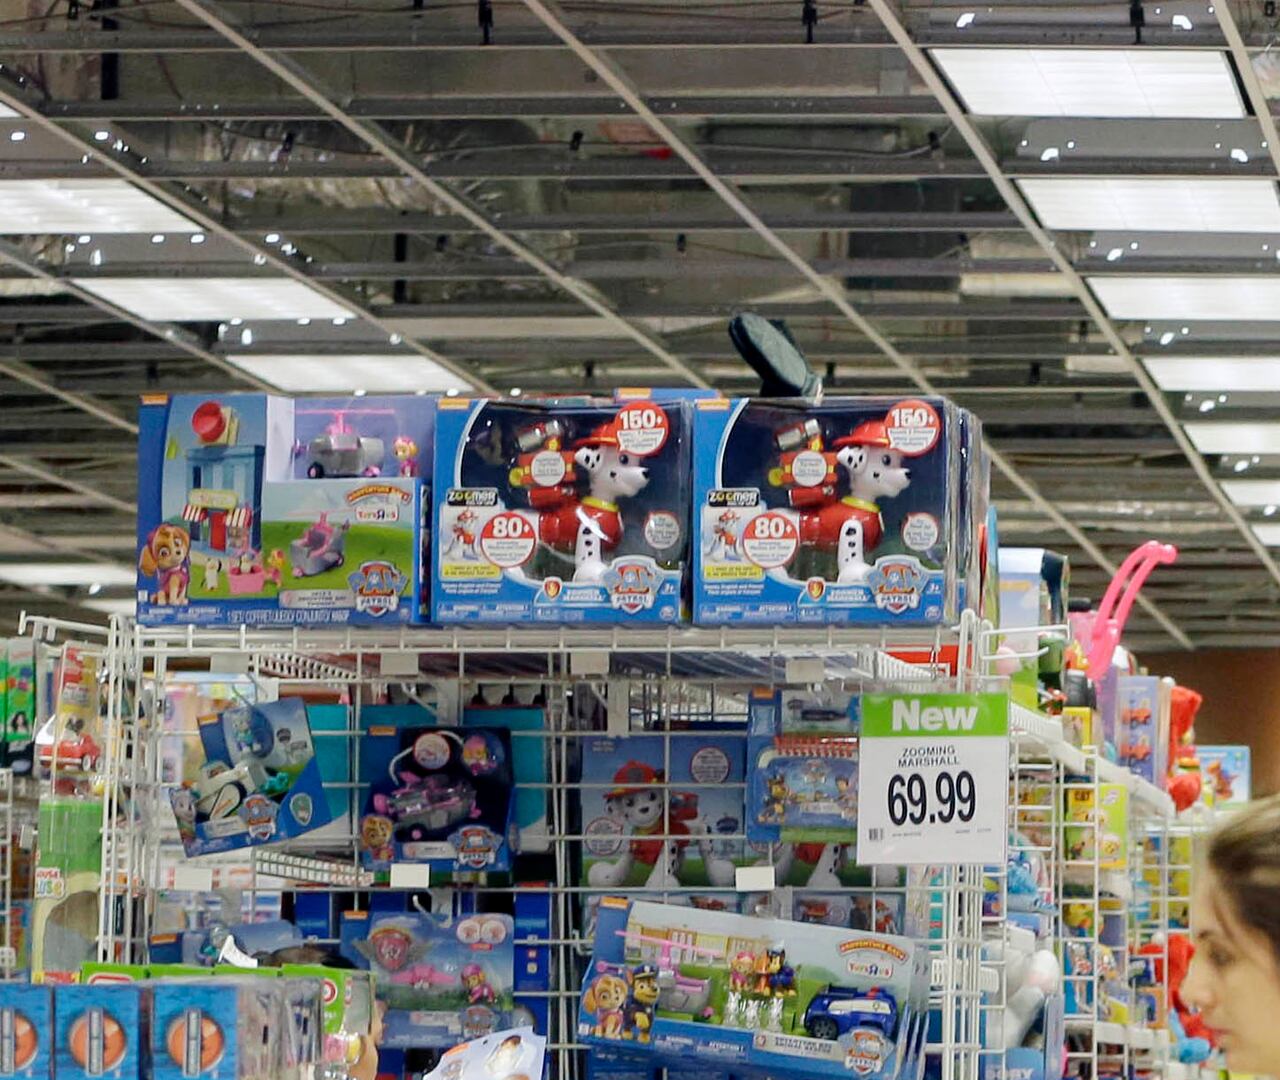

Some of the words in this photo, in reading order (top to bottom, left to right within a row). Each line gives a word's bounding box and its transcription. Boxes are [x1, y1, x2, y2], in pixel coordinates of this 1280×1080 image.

[492, 517, 531, 538] 80+
[754, 517, 793, 538] 80+
[892, 699, 979, 731] New
[898, 756, 961, 768] MARSHALL
[901, 745, 956, 758] ZOOMING
[887, 769, 977, 827] 69.99
